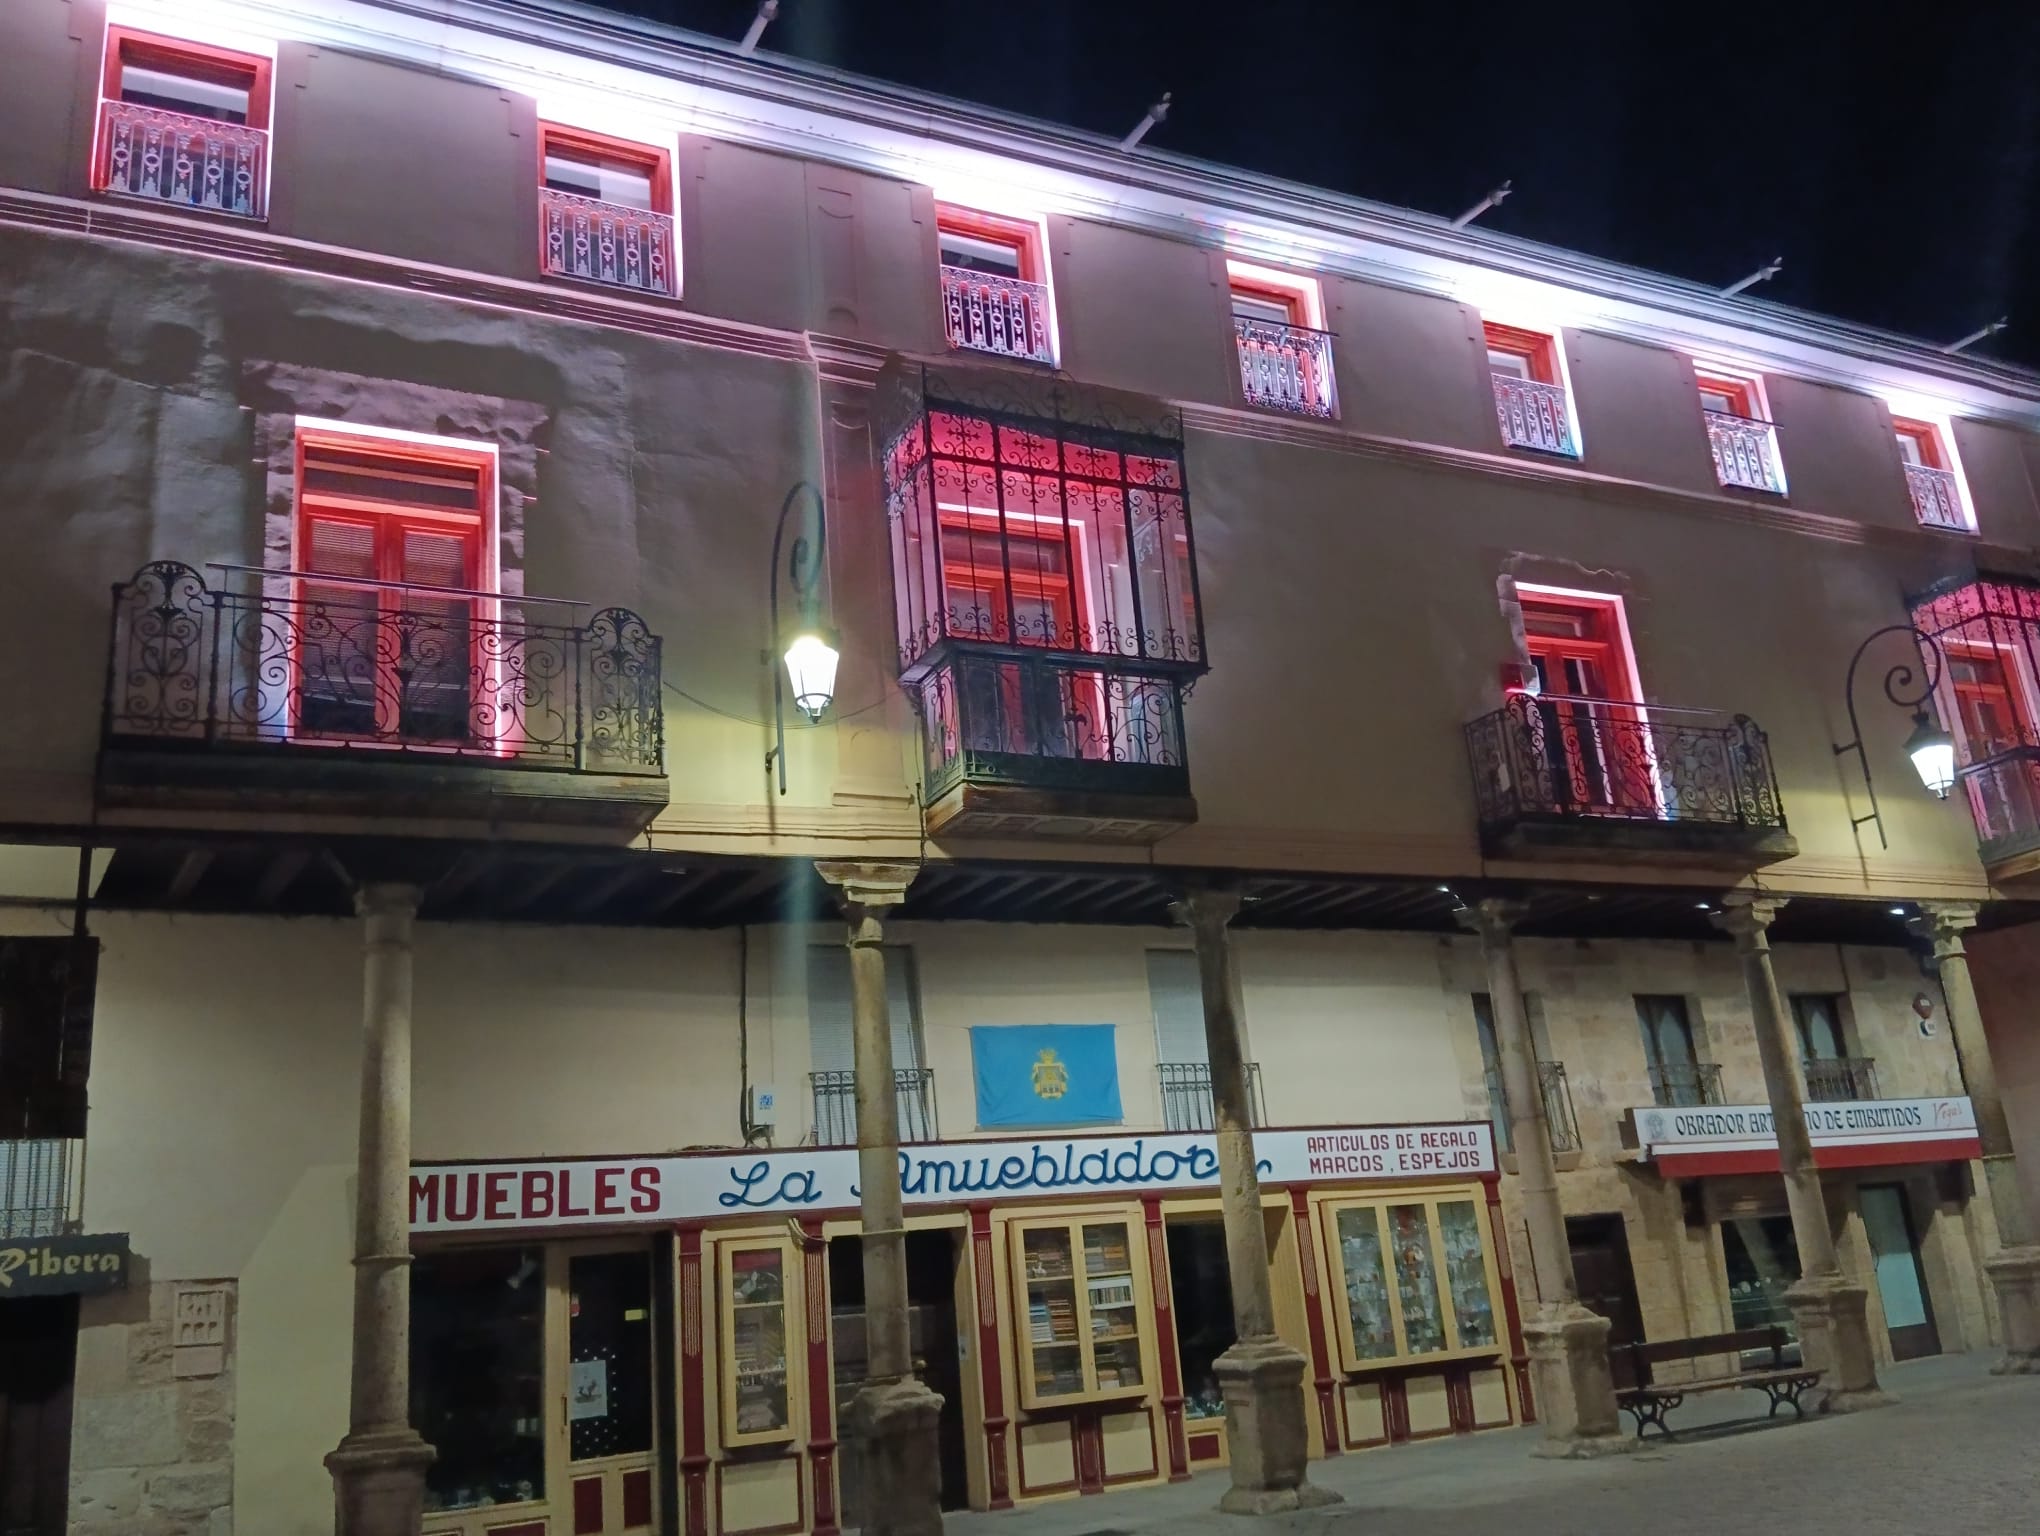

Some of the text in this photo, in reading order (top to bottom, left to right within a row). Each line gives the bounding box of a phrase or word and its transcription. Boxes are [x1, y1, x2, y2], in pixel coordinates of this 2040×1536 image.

[1675, 1112, 1746, 1136] OBRADOR
[1823, 1109, 1844, 1130] DE
[1846, 1106, 1922, 1129] EMBUTIDOS
[1307, 1131, 1477, 1154] ARTICULOS DE REGALO
[1399, 1150, 1480, 1171] ESPEJOS
[409, 1166, 660, 1224] MUEBLES
[718, 1160, 822, 1207] La
